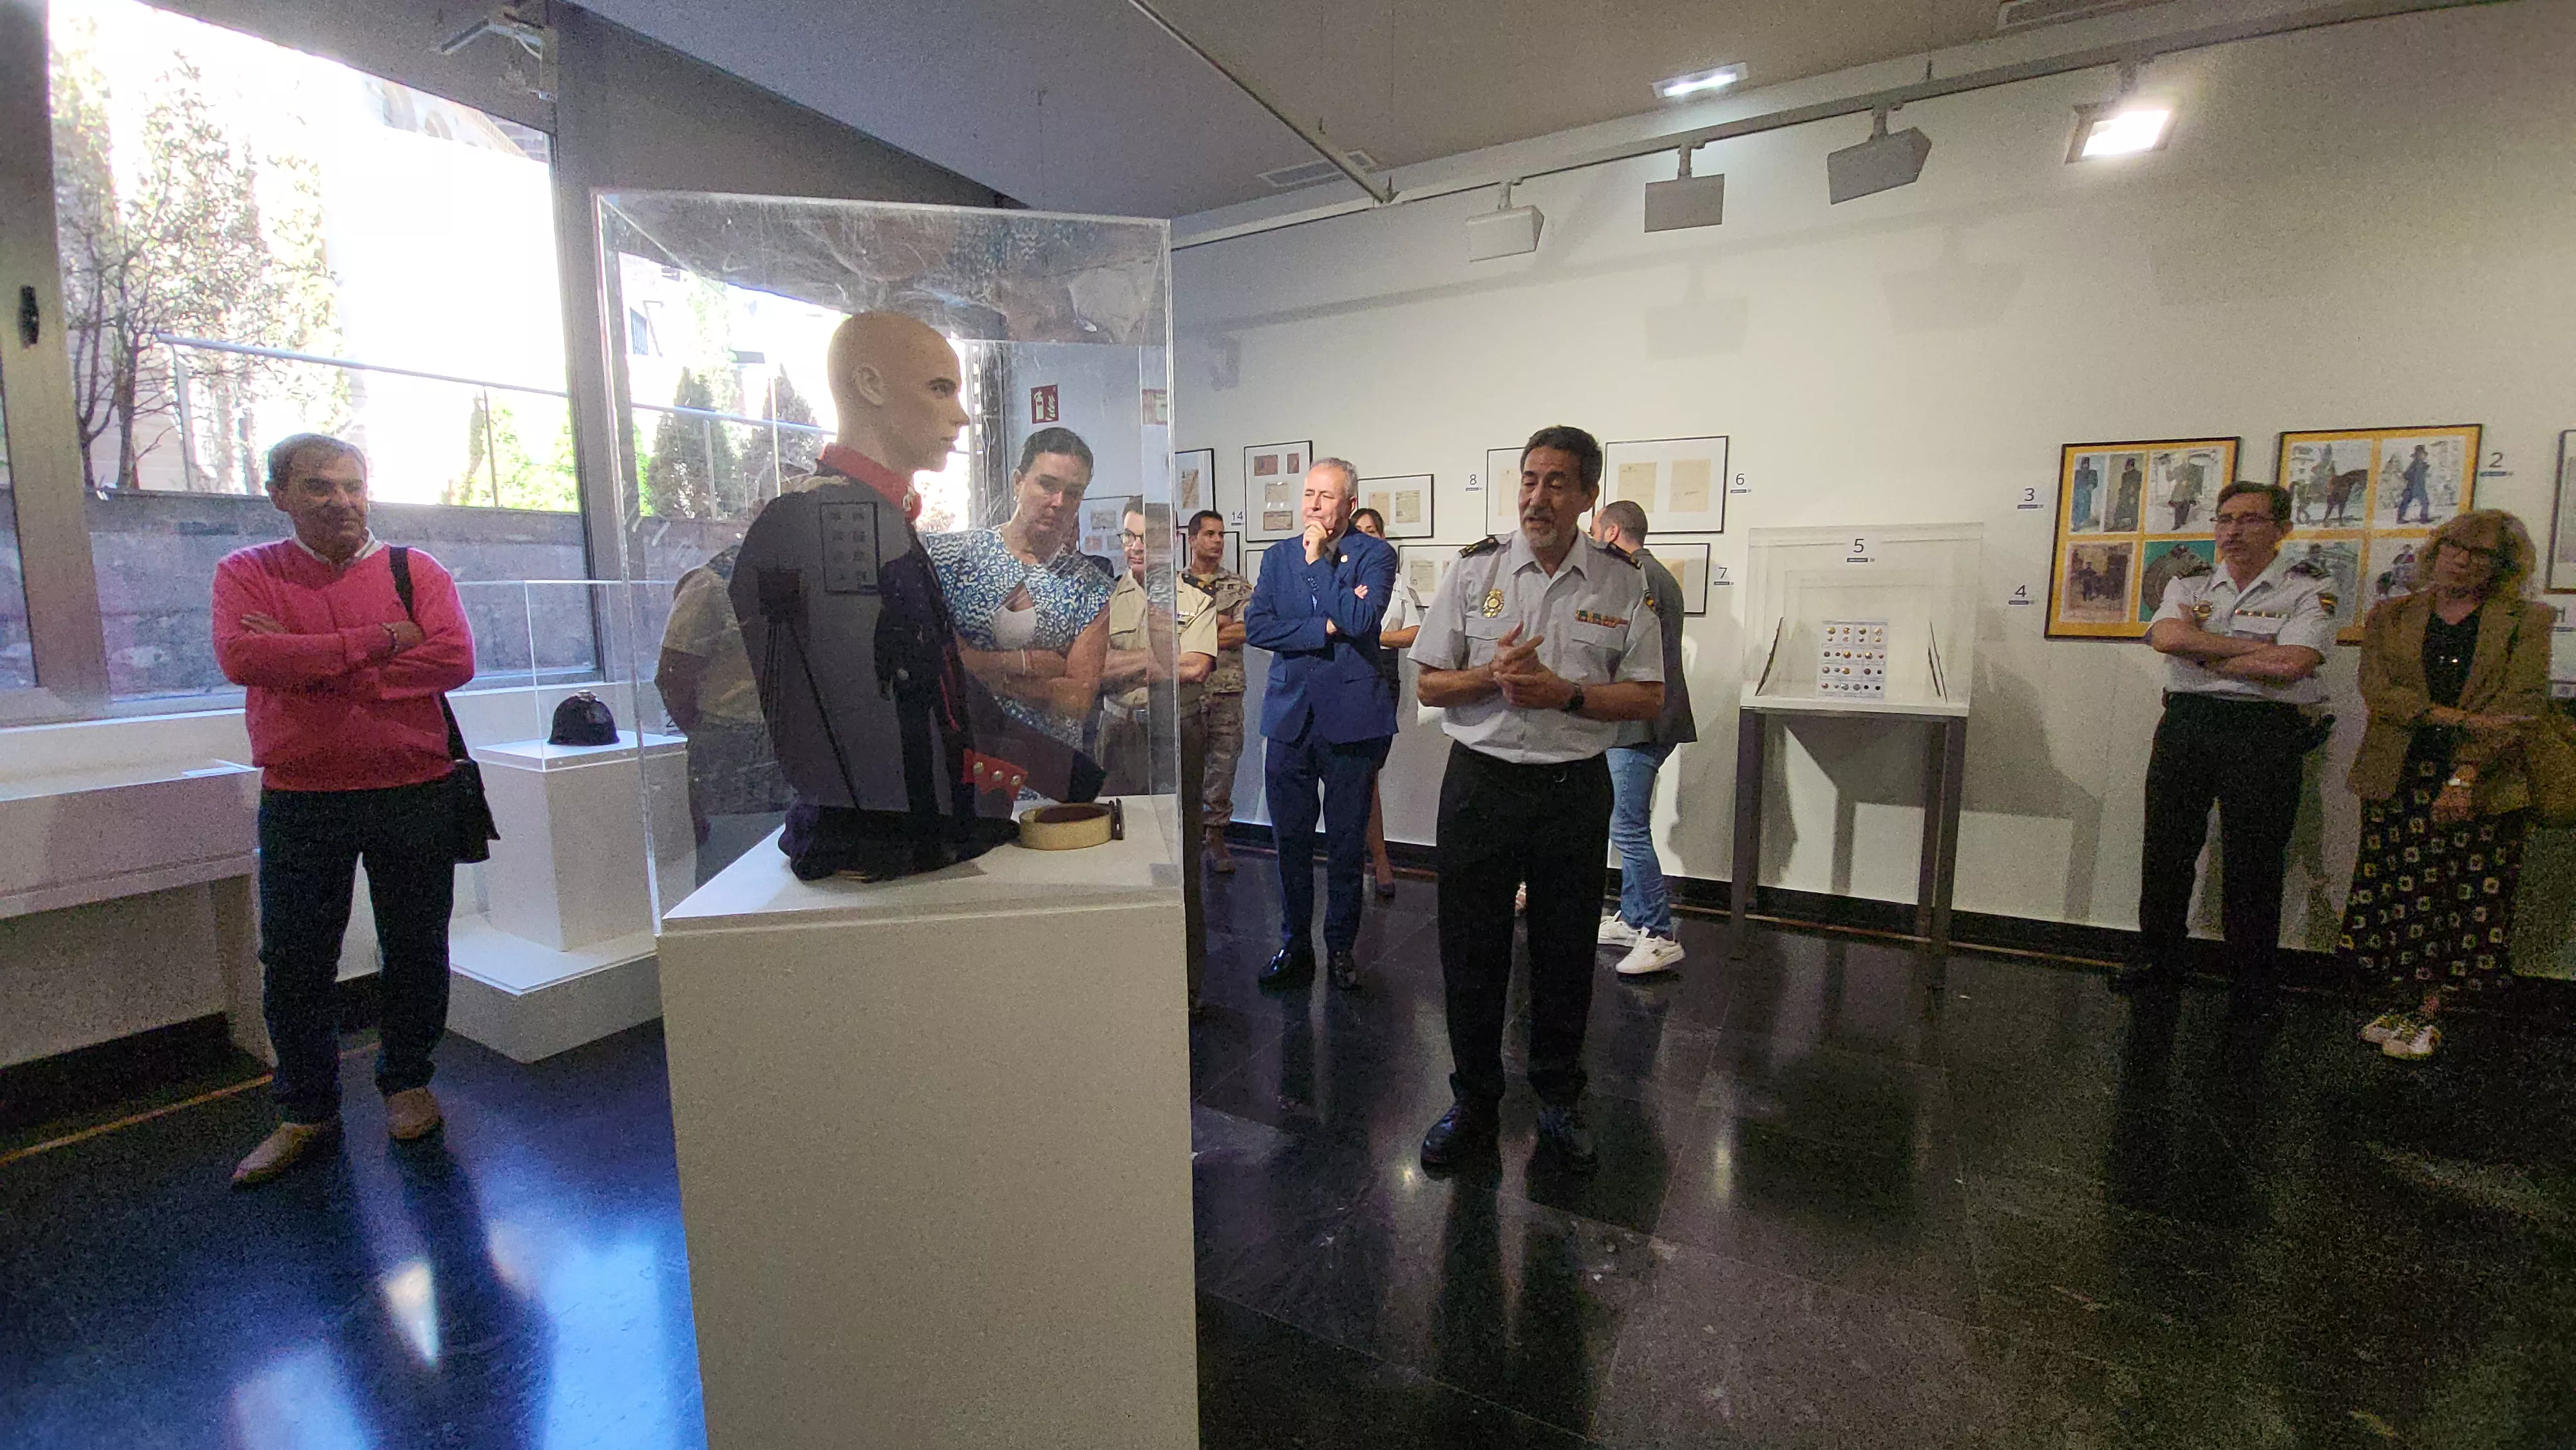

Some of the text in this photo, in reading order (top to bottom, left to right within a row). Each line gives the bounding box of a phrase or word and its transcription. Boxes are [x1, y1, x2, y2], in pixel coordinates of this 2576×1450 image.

[2488, 452, 2503, 468] 2
[1470, 474, 1477, 485] 8
[1736, 473, 1745, 485] 6
[2024, 487, 2035, 502] 3
[1231, 511, 1243, 521] 14
[1853, 538, 1865, 553] 5
[1719, 567, 1728, 579] 7
[2014, 584, 2027, 598] 4
